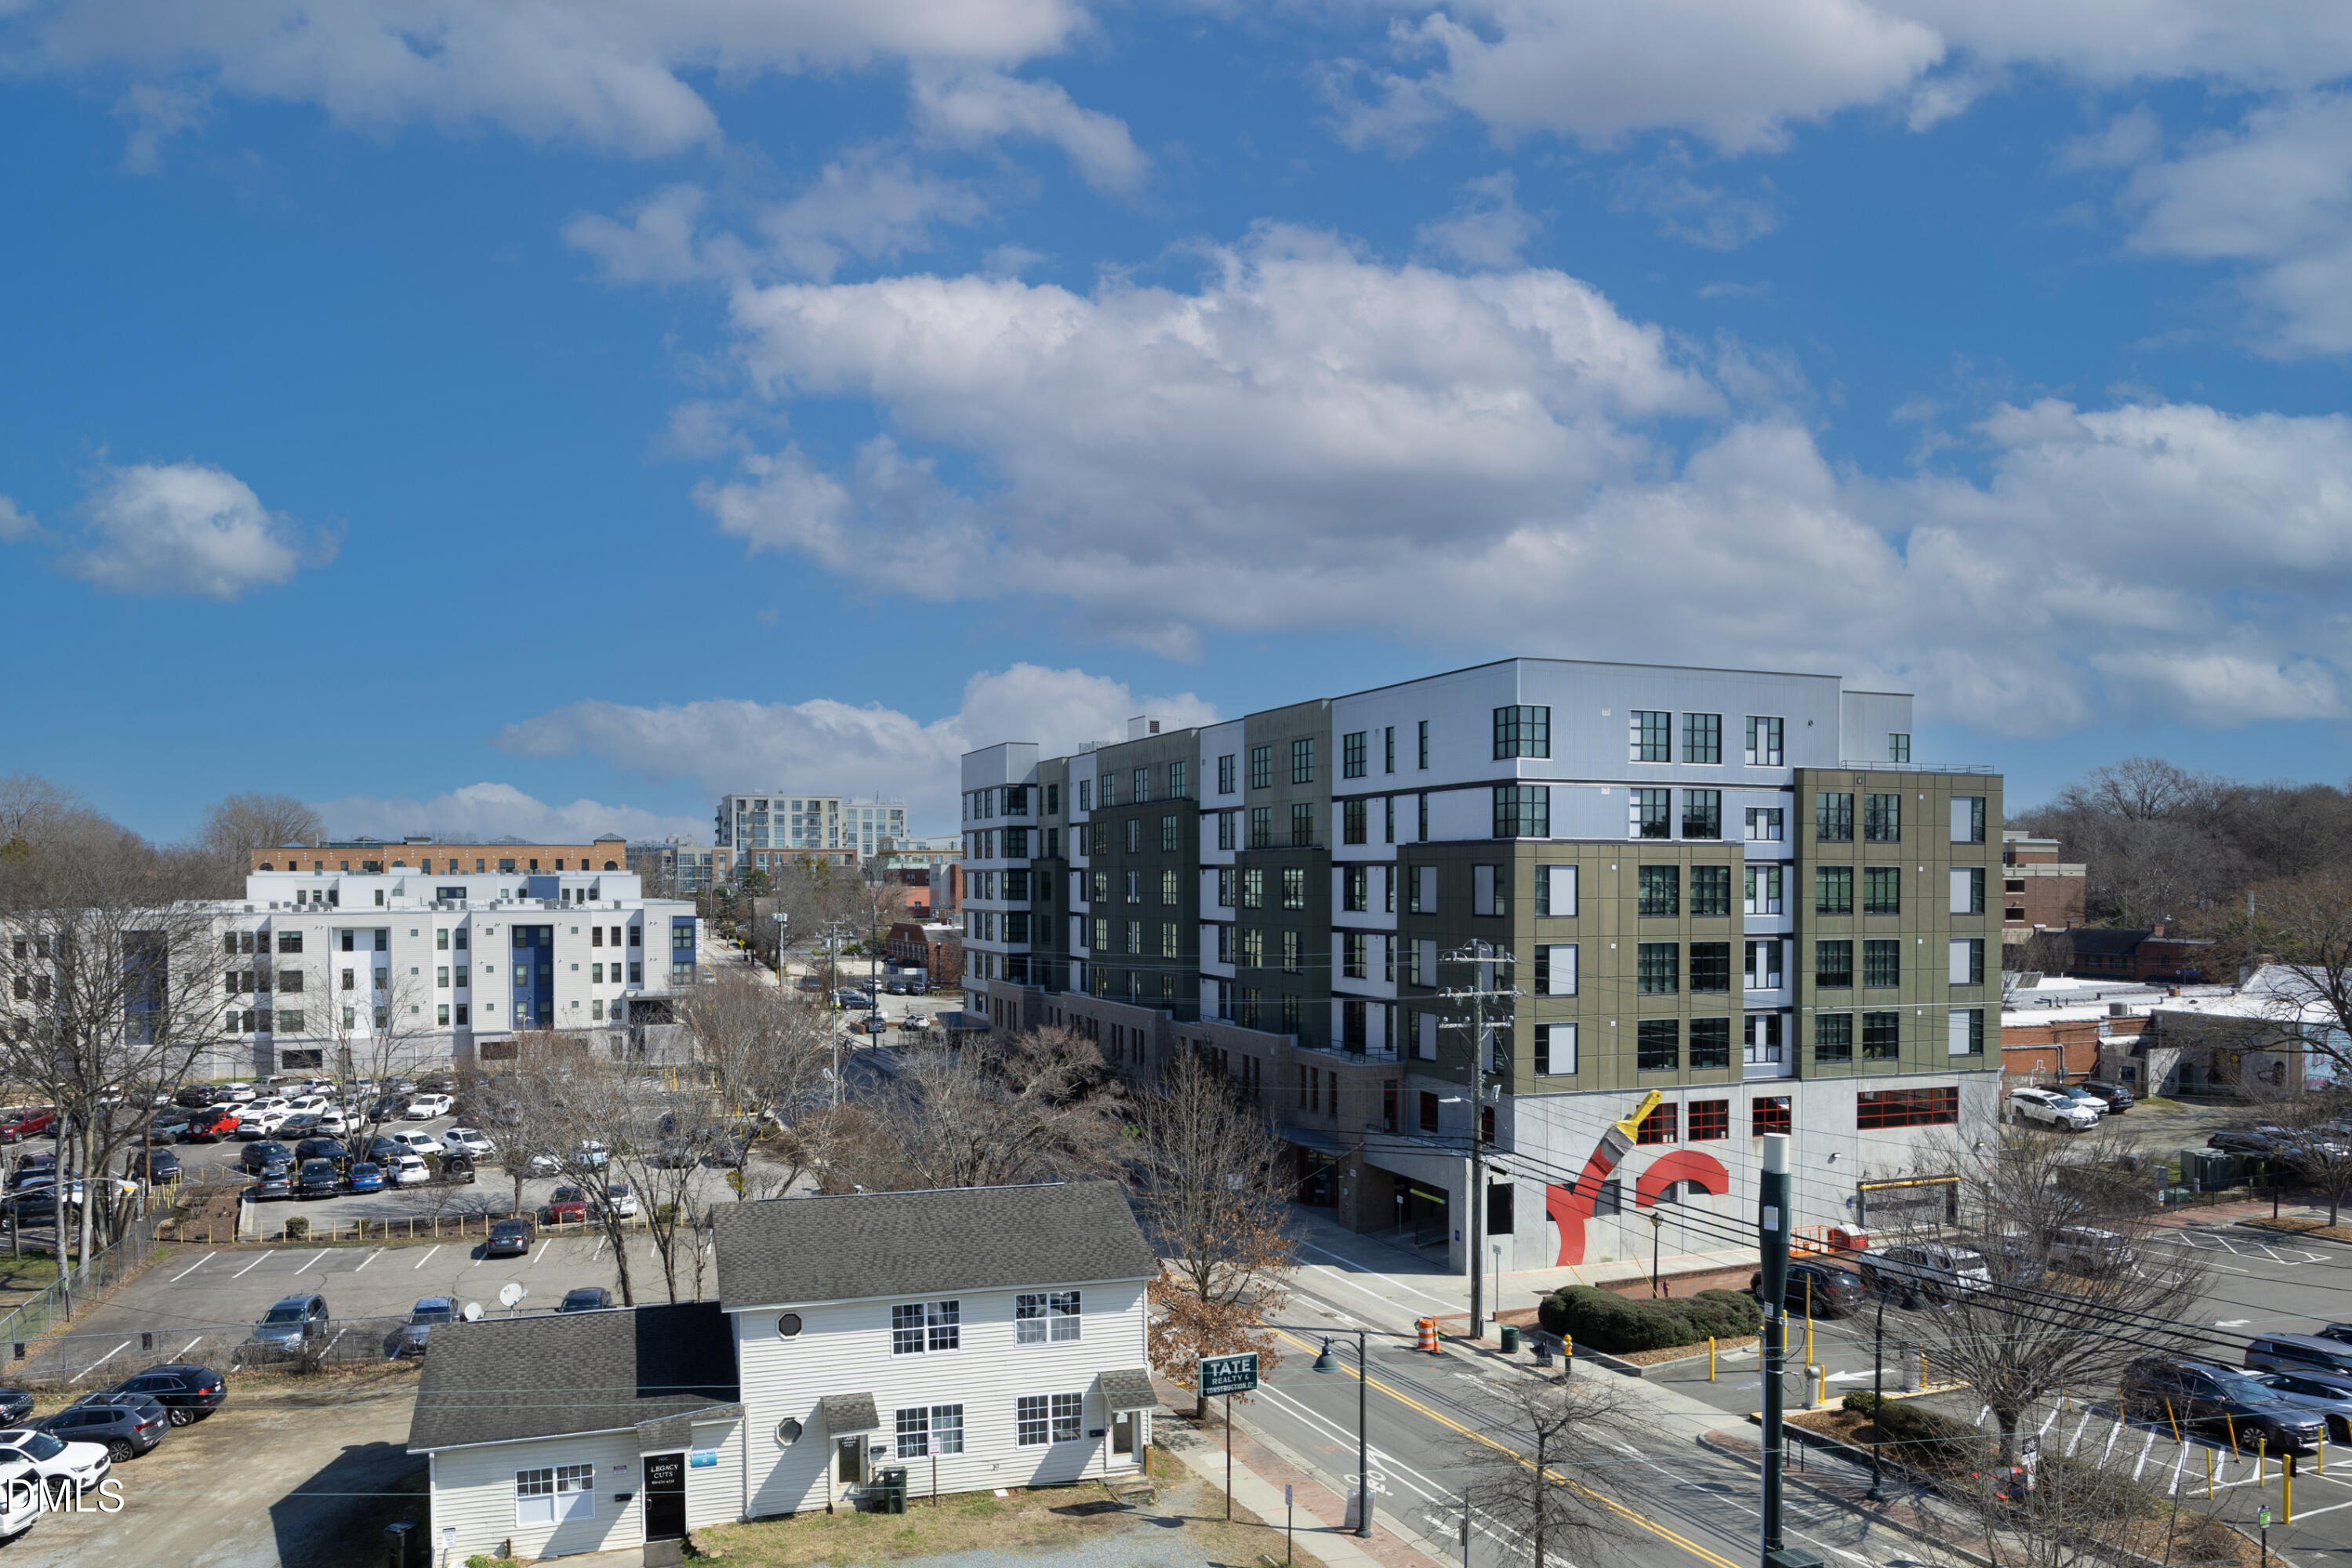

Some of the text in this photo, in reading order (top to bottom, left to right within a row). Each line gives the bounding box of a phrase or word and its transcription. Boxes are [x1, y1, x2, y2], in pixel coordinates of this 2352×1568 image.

[1210, 1359, 1250, 1377] TATE
[1212, 1374, 1243, 1385] REALTY
[1207, 1382, 1247, 1394] CONSTRUCTION
[651, 1464, 678, 1473] LEGACY
